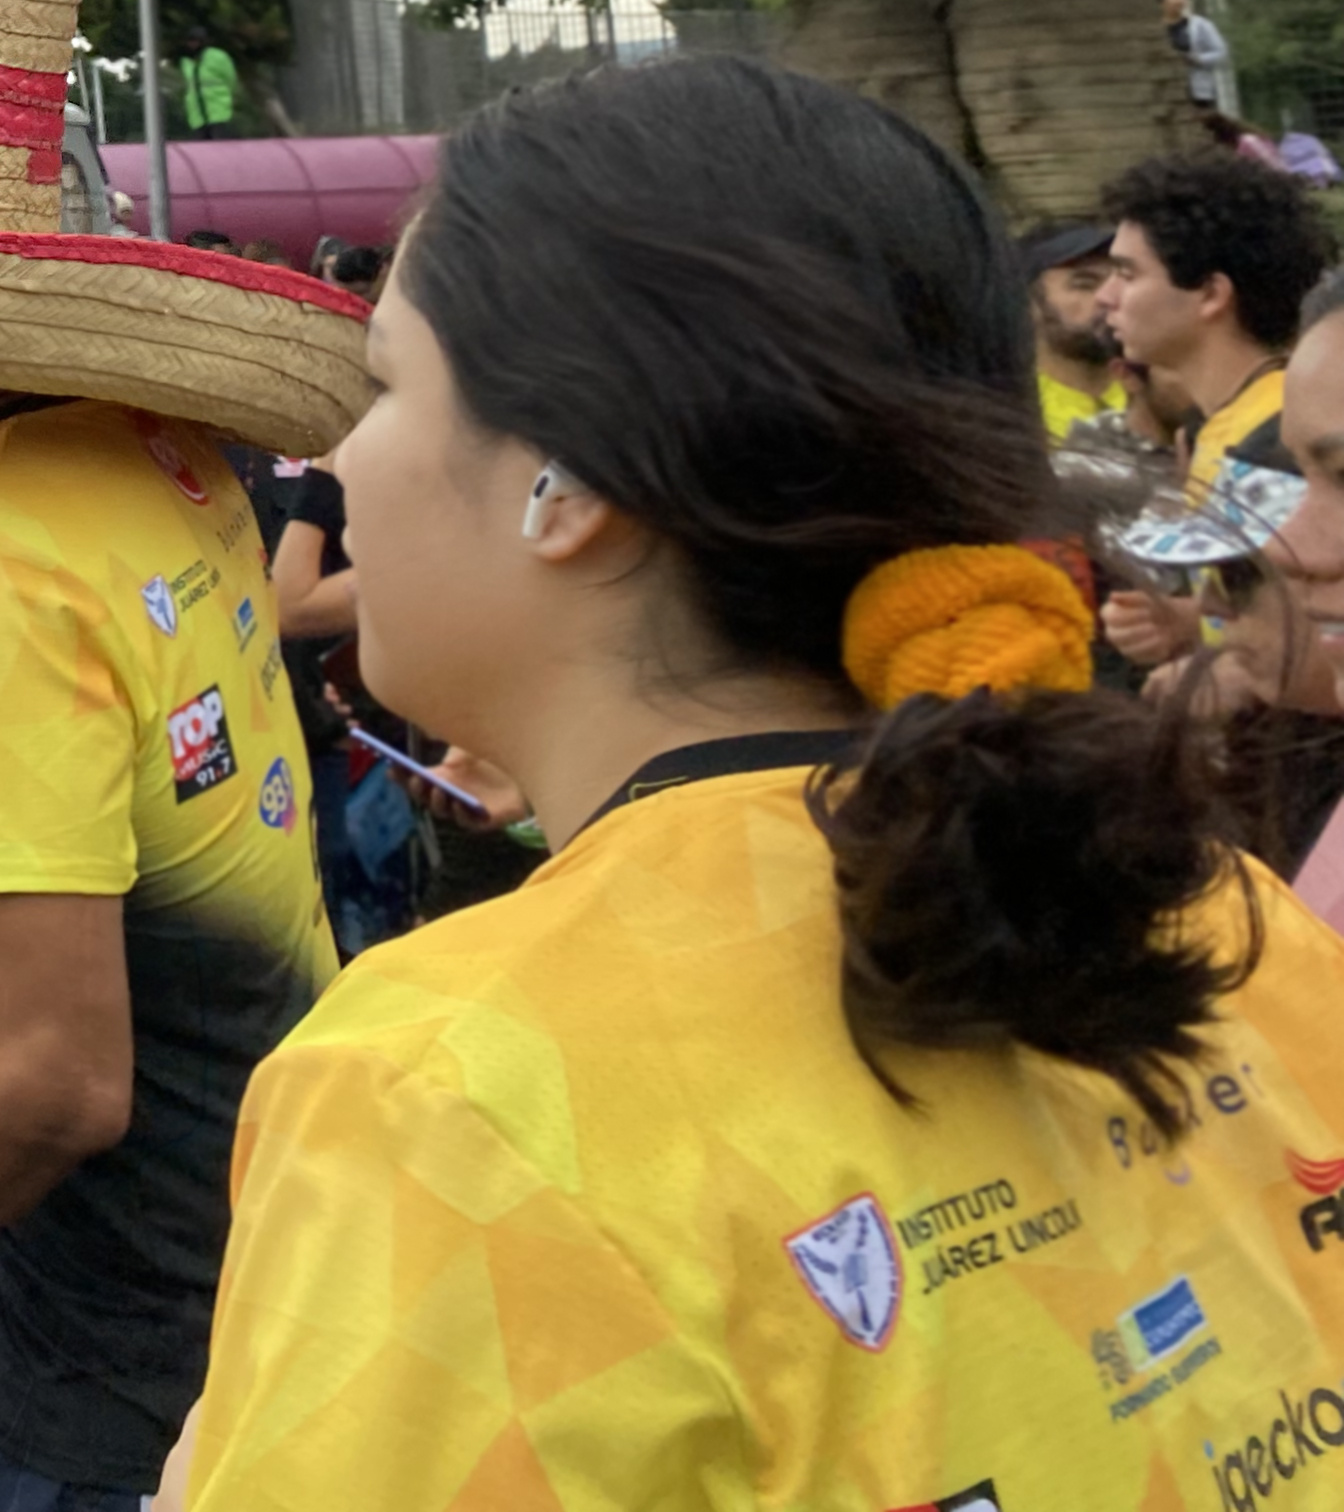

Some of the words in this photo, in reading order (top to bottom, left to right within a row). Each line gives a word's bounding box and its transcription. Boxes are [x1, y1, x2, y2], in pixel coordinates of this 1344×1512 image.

[168, 690, 223, 759] TOP
[196, 757, 230, 787] 91.7
[896, 1179, 1018, 1250] INSTITUTO
